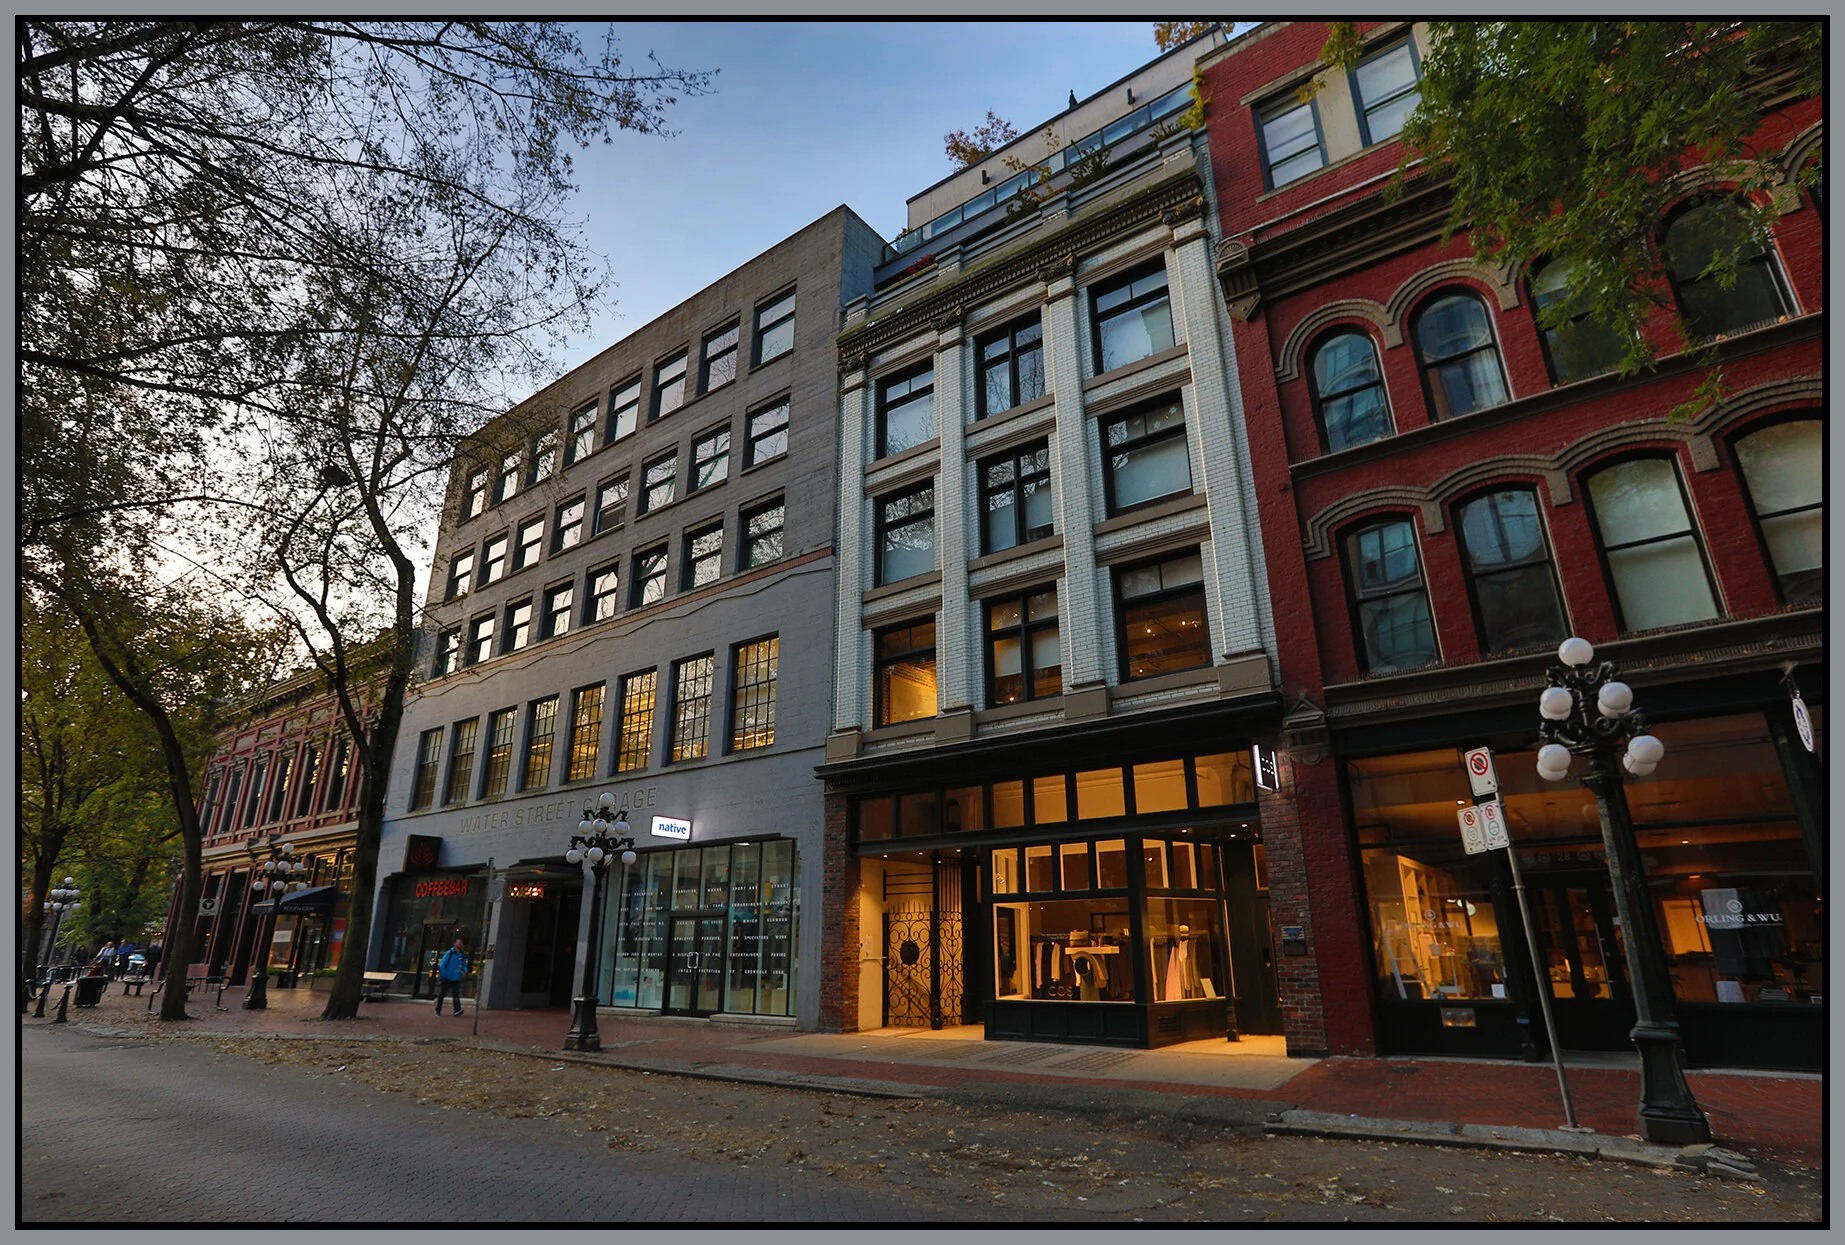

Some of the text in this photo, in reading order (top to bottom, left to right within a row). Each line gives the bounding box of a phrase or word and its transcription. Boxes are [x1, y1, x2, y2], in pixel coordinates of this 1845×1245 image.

[460, 786, 657, 833] WATER STREET GAGE
[658, 823, 687, 835] native
[415, 880, 469, 898] COFFEEBAR
[1747, 912, 1756, 922] &
[1047, 985, 1074, 998] COS
